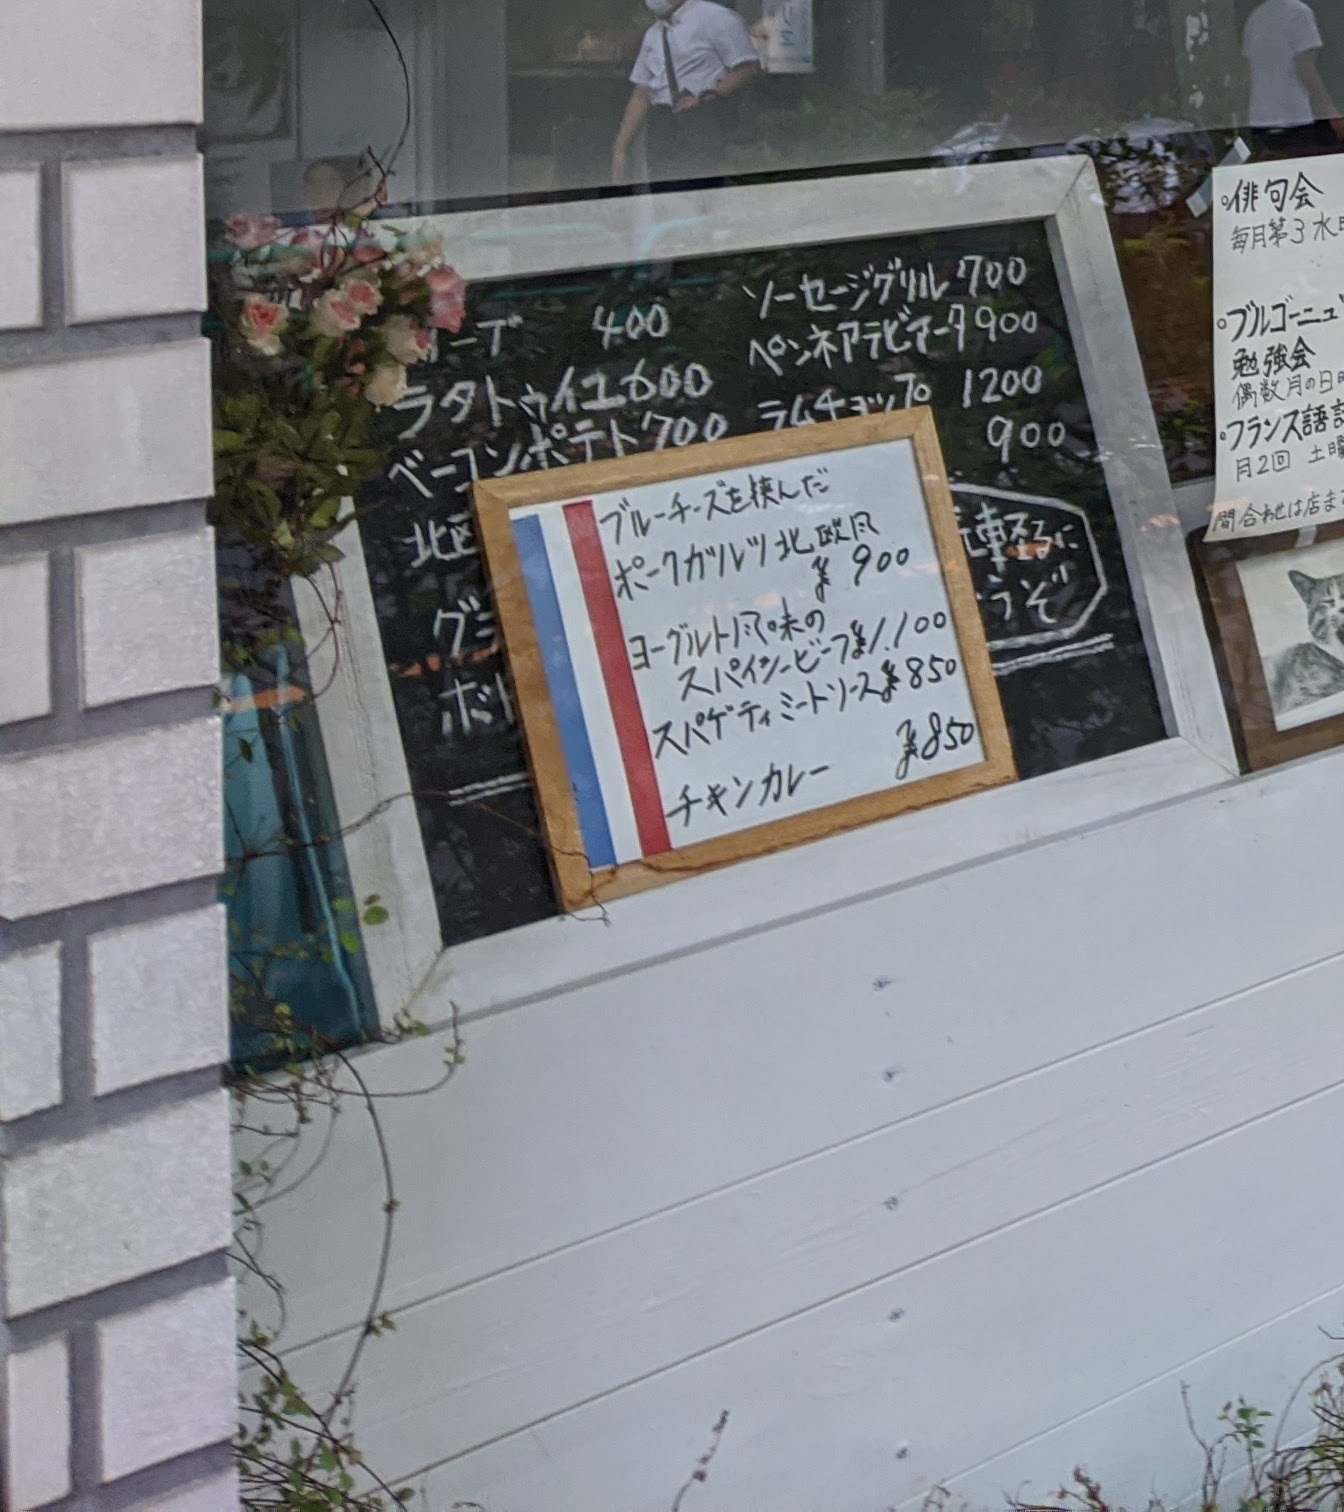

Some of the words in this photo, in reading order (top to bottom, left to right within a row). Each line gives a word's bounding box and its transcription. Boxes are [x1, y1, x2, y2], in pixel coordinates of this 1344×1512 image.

[957, 255, 1028, 298] 700
[592, 303, 670, 350] 400
[974, 305, 1038, 343] 900
[1231, 335, 1318, 381] 勉強会
[962, 365, 1043, 408] 1200
[987, 415, 1067, 464] 900
[666, 761, 830, 827] チキンカレー
